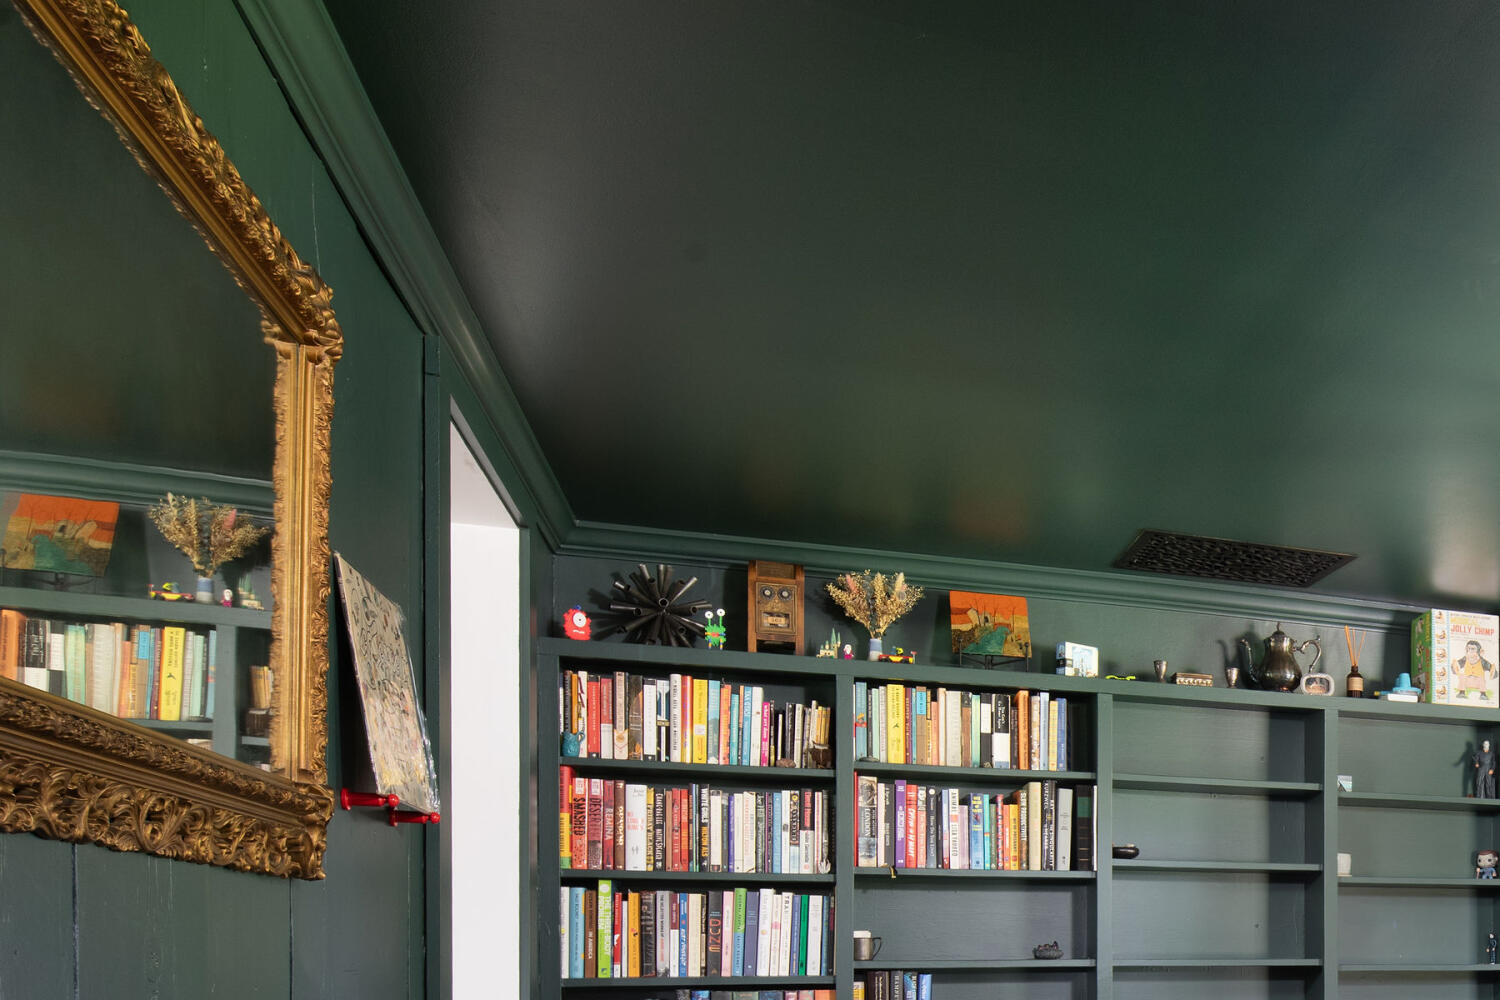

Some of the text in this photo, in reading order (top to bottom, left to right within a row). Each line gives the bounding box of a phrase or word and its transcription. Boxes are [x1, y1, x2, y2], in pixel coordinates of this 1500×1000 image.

[1450, 625, 1495, 637] JOLLY CHIMP
[701, 788, 709, 807] WHITE
[574, 798, 585, 835] SMASHED
[605, 808, 613, 840] REMINA
[701, 807, 709, 823] GIRLS
[701, 827, 709, 846] HILTON
